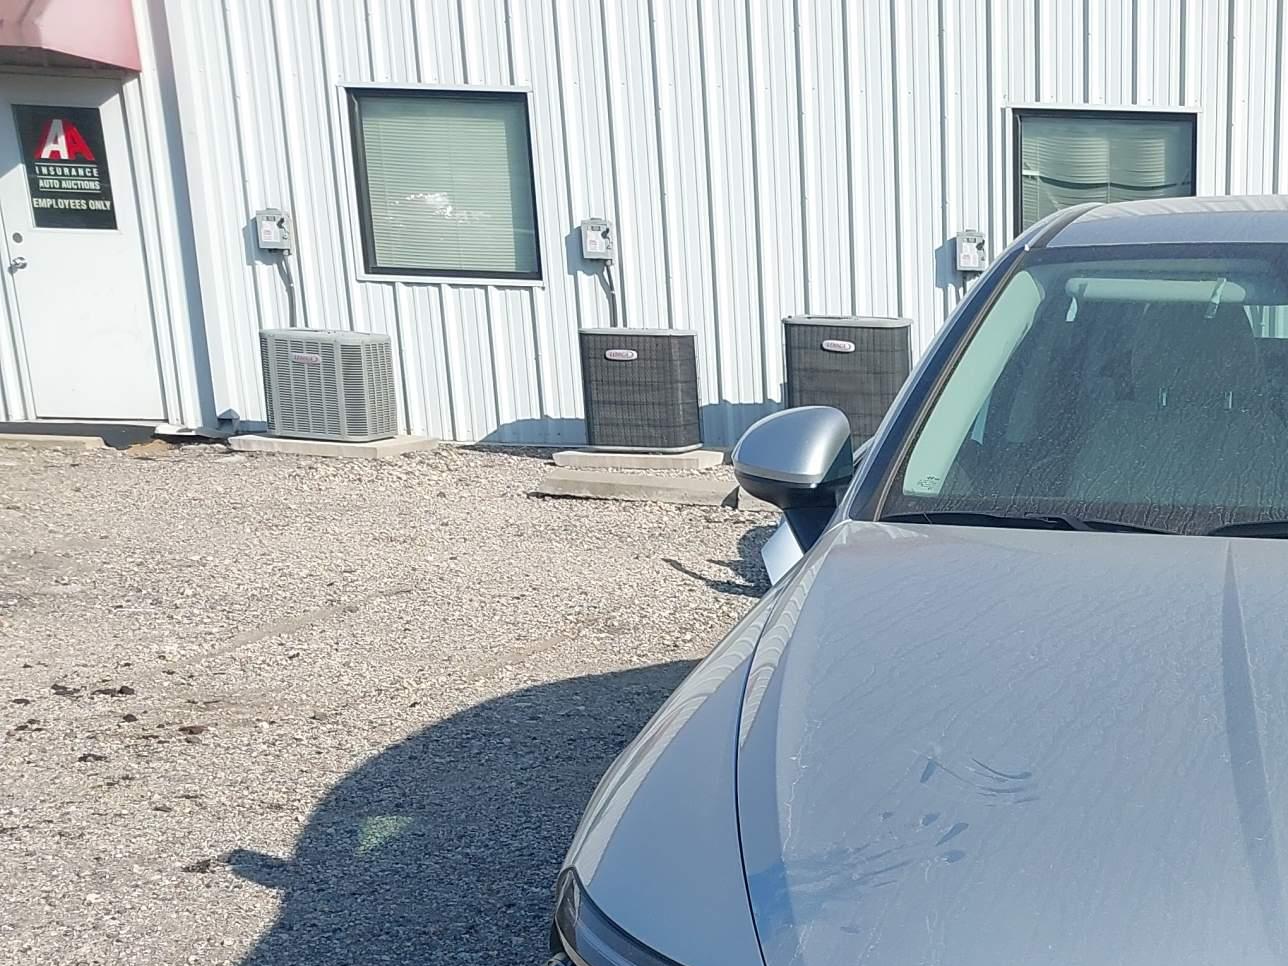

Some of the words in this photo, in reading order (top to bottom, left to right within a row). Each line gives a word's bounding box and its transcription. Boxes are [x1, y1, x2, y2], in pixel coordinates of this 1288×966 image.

[35, 166, 99, 177] INSURANCE
[39, 179, 60, 188] AUTO
[61, 180, 101, 190] AUCTIONS
[32, 198, 88, 209] EMPLOYEES
[88, 199, 111, 210] ONLY
